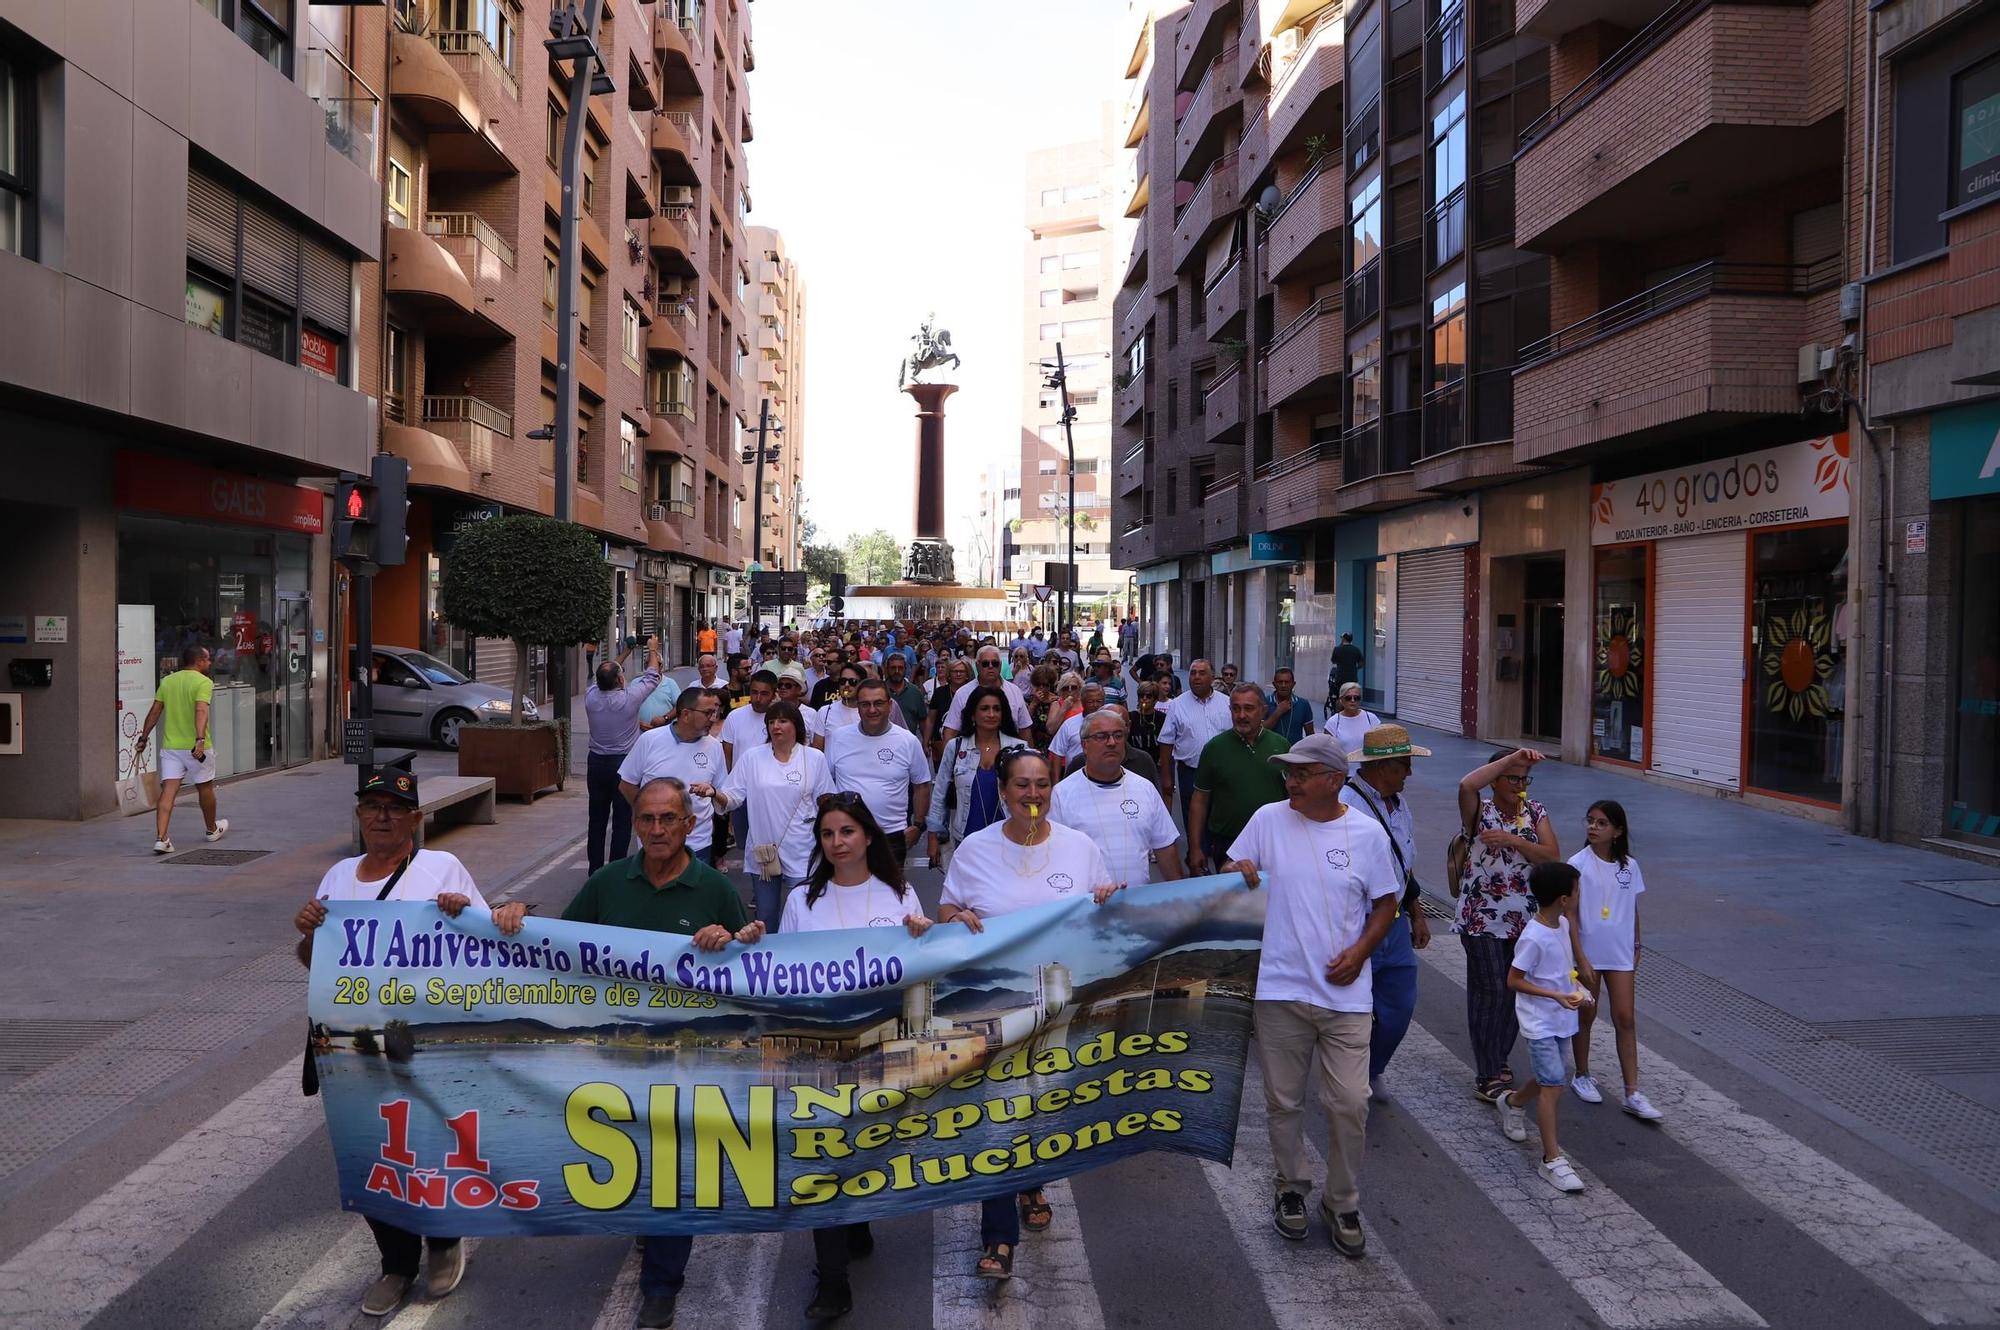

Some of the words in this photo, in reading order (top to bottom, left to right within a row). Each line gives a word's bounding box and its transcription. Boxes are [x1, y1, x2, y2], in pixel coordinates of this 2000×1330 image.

[213, 478, 266, 516] GAES
[1635, 479, 1666, 515] 40
[1674, 458, 1779, 518] grados
[292, 512, 321, 528] amplifon
[1615, 530, 1635, 541] MODA
[1635, 524, 1668, 539] INTERIOR
[1673, 519, 1695, 534] BAÑO
[1701, 515, 1742, 530] LENCERIA
[1749, 506, 1809, 524] CORSETERIA
[824, 689, 841, 702] Loi
[338, 918, 379, 968] XI
[384, 918, 572, 974] Aniversario
[578, 941, 667, 986] Riada
[676, 952, 734, 996] San
[742, 946, 904, 998] Wenceslao
[333, 976, 369, 1005] 28
[378, 976, 416, 1006] de
[425, 977, 597, 1012] Septiembre
[605, 982, 641, 1008] de
[648, 984, 719, 1009] 2023
[789, 1028, 1191, 1120] Novedades
[377, 1098, 491, 1174] 11
[789, 1064, 1214, 1160] Respuestas
[562, 1081, 780, 1211] SIN
[365, 1162, 541, 1210] AÑOS
